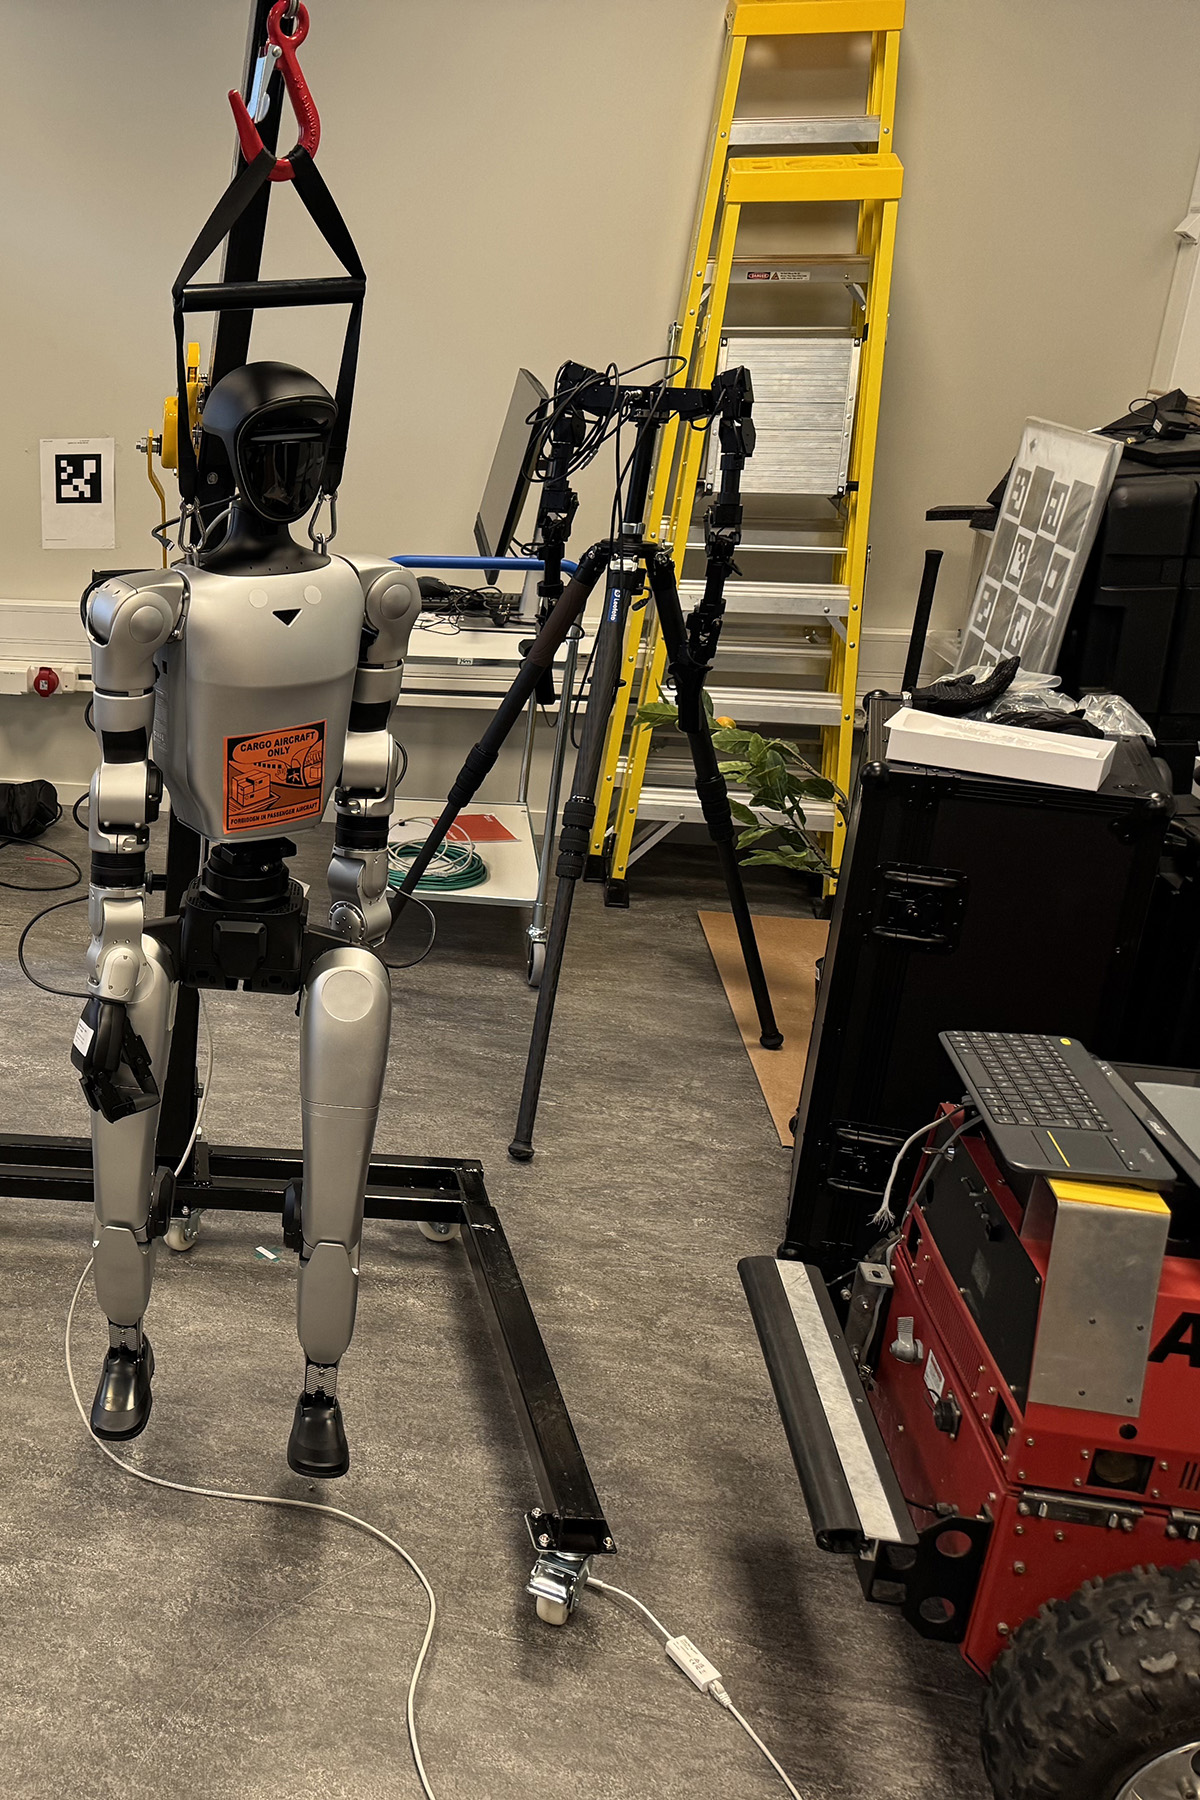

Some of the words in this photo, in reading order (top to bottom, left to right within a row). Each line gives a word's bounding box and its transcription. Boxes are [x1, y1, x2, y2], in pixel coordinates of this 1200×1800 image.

[611, 598, 620, 621] Leofoto
[240, 740, 272, 752] CARGO
[274, 731, 316, 747] AIRCRAFT
[267, 746, 291, 757] ONLY
[230, 815, 260, 825] FORBIDDEN
[267, 808, 295, 819] PASSENGER
[296, 802, 318, 813] AIRCRAFT
